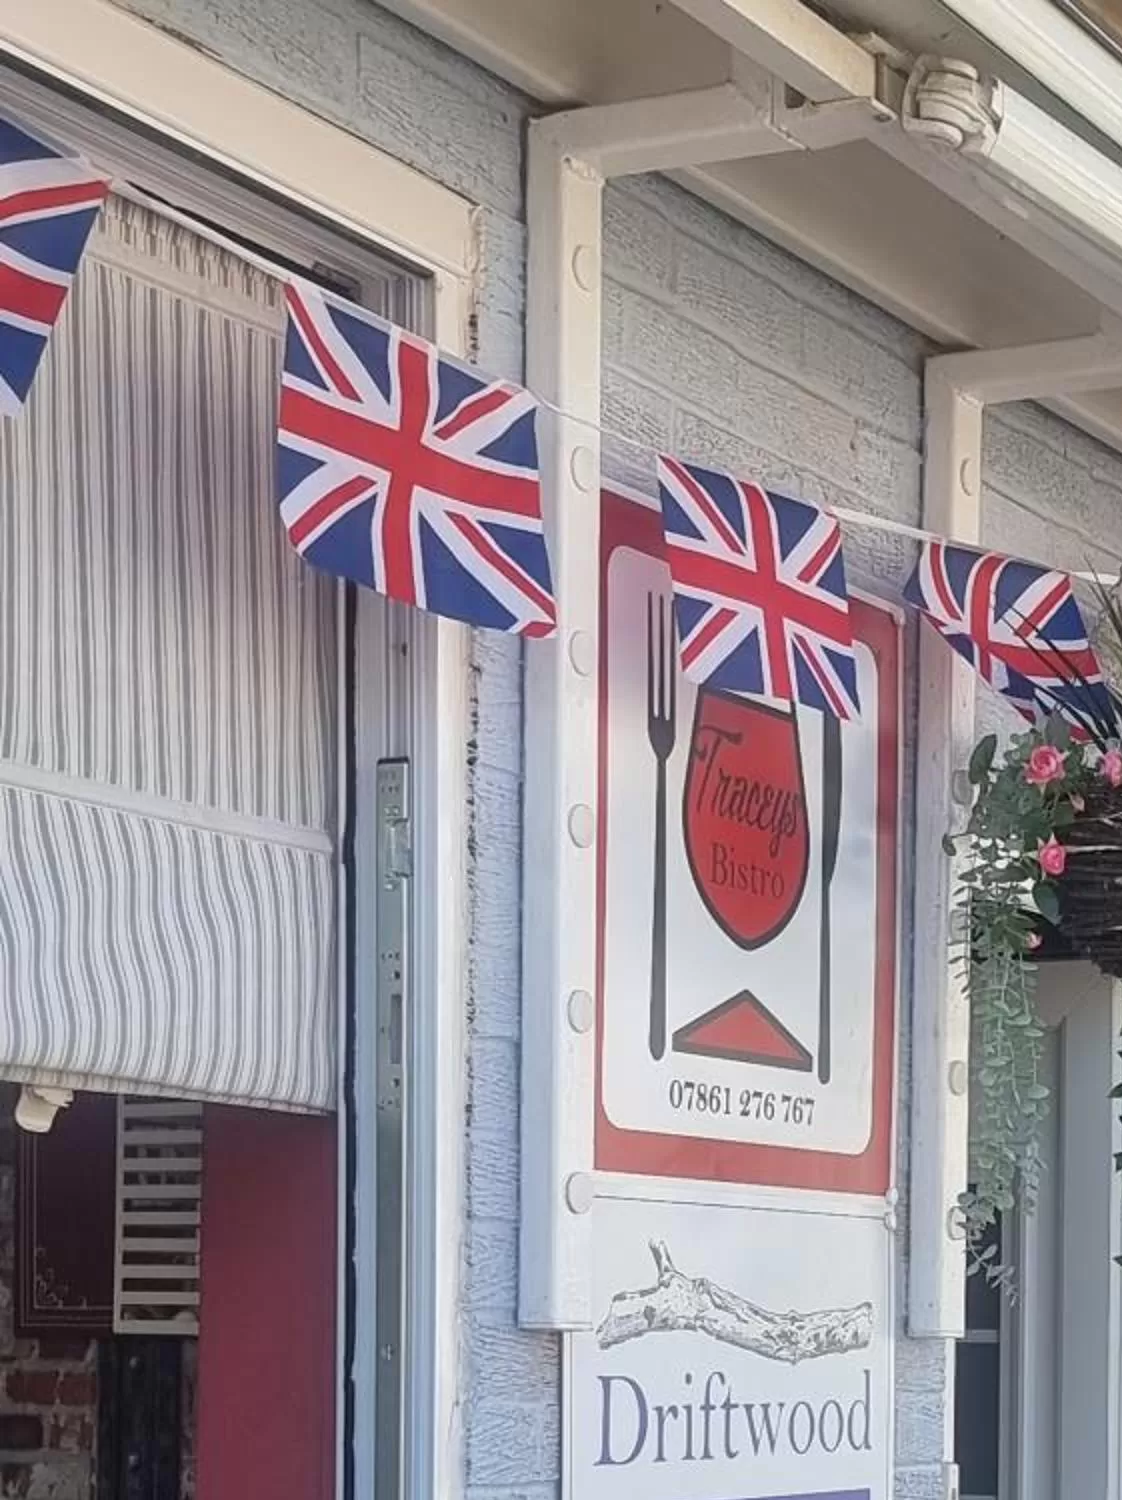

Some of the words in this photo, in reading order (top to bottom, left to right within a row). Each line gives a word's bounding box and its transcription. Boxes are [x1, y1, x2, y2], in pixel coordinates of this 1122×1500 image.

[694, 724, 798, 858] Traceys
[711, 843, 785, 898] Bistro
[669, 1080, 731, 1115] 07861
[739, 1089, 776, 1120] 276
[781, 1093, 815, 1126] 767
[593, 1369, 872, 1466] Driftwood
